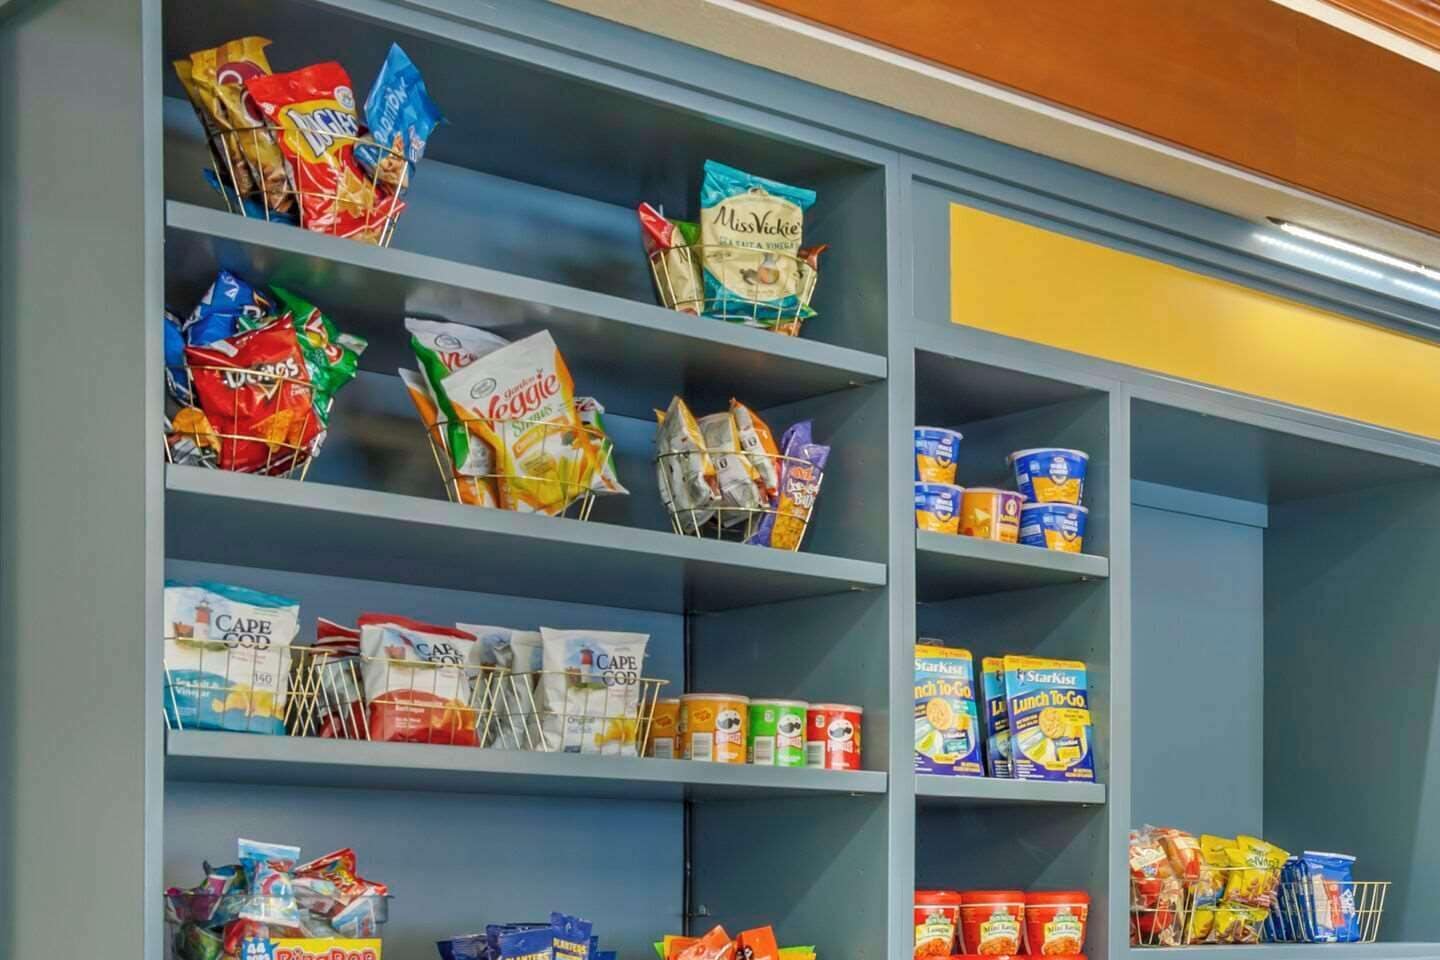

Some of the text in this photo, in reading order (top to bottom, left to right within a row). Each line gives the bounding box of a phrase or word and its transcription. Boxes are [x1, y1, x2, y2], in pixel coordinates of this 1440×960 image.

[473, 371, 560, 433] Veggie
[216, 614, 272, 635] CAPE
[596, 654, 638, 671] CAPE
[602, 670, 637, 687] COD
[1026, 670, 1076, 686] StarKist
[914, 682, 936, 698] nch
[1013, 692, 1049, 711] Lunch
